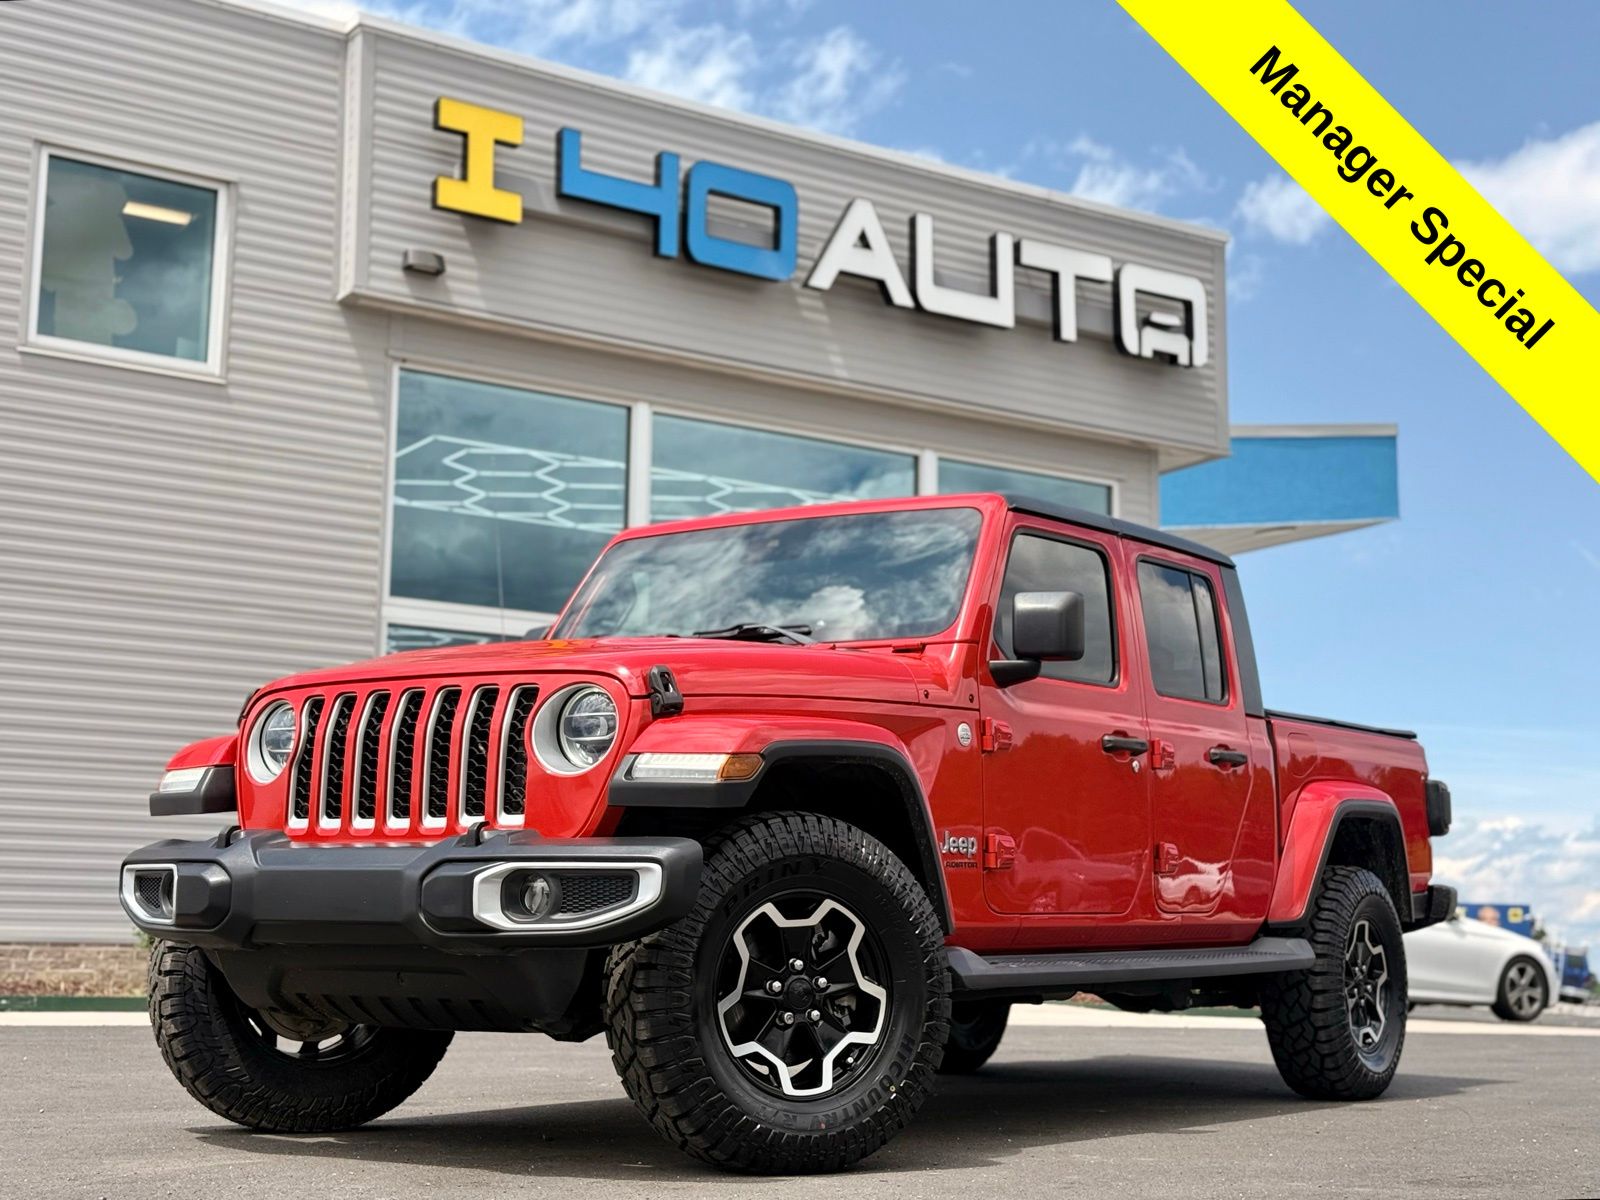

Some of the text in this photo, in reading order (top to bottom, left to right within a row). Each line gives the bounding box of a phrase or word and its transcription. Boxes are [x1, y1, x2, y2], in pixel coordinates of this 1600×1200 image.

[434, 96, 525, 224] I
[557, 126, 798, 281] 40
[940, 830, 977, 858] Jeep
